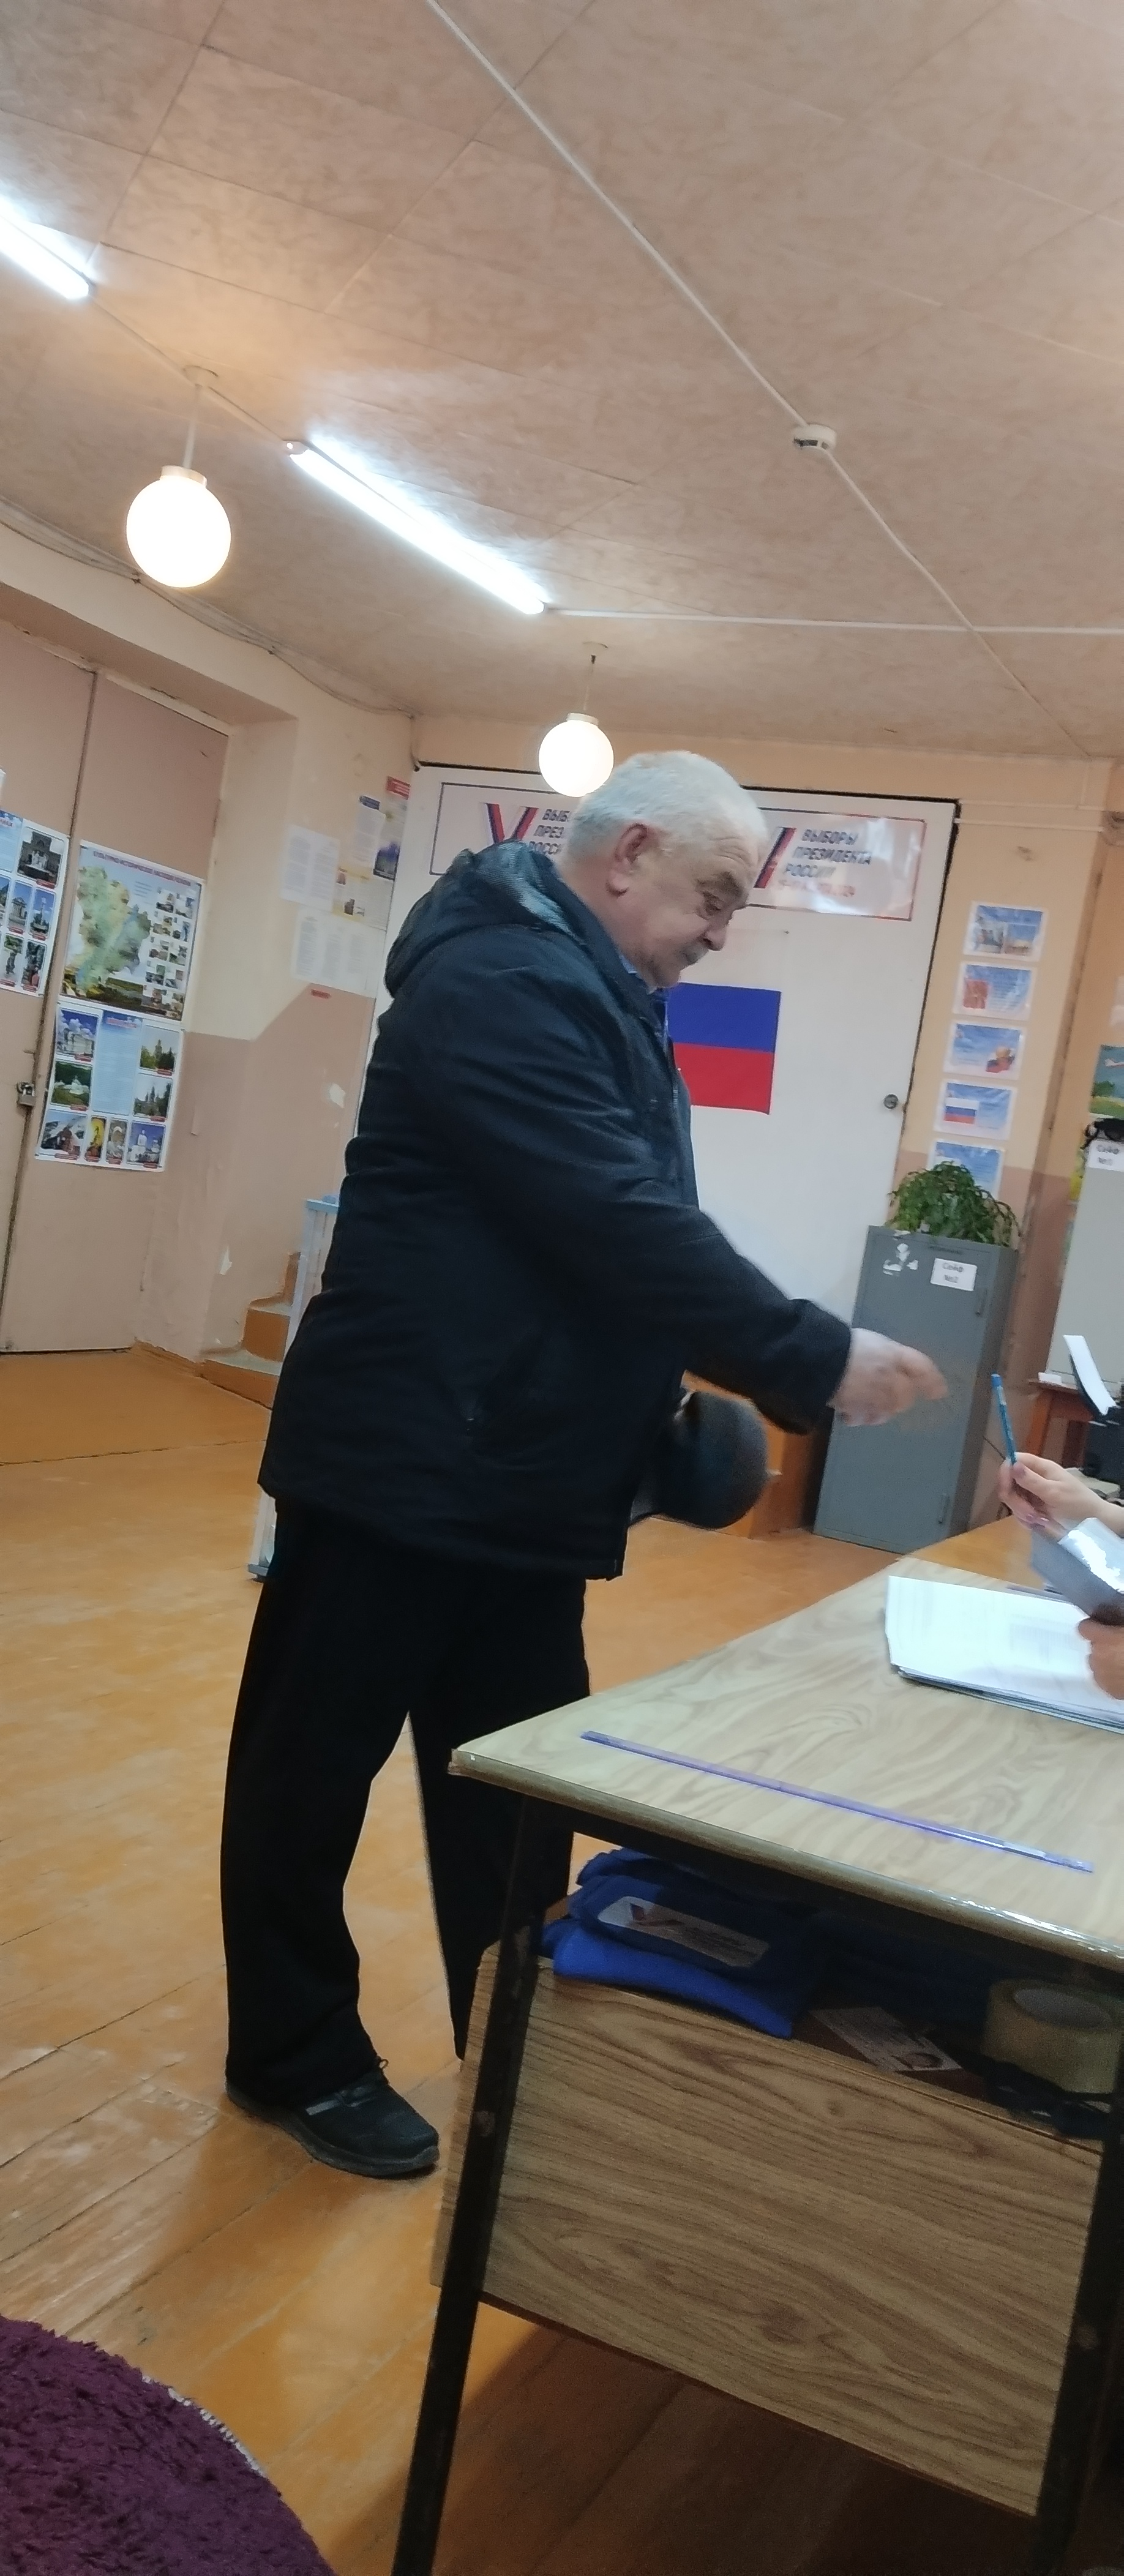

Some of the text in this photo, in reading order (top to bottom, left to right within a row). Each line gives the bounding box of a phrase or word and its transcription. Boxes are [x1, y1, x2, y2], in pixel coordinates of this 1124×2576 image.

[542, 808, 570, 822] ВЫБ
[533, 825, 564, 839] ПРЕЗ
[801, 828, 858, 845] ВЫБОРЫ
[793, 846, 872, 865] ПРЕЗИДЕНТА
